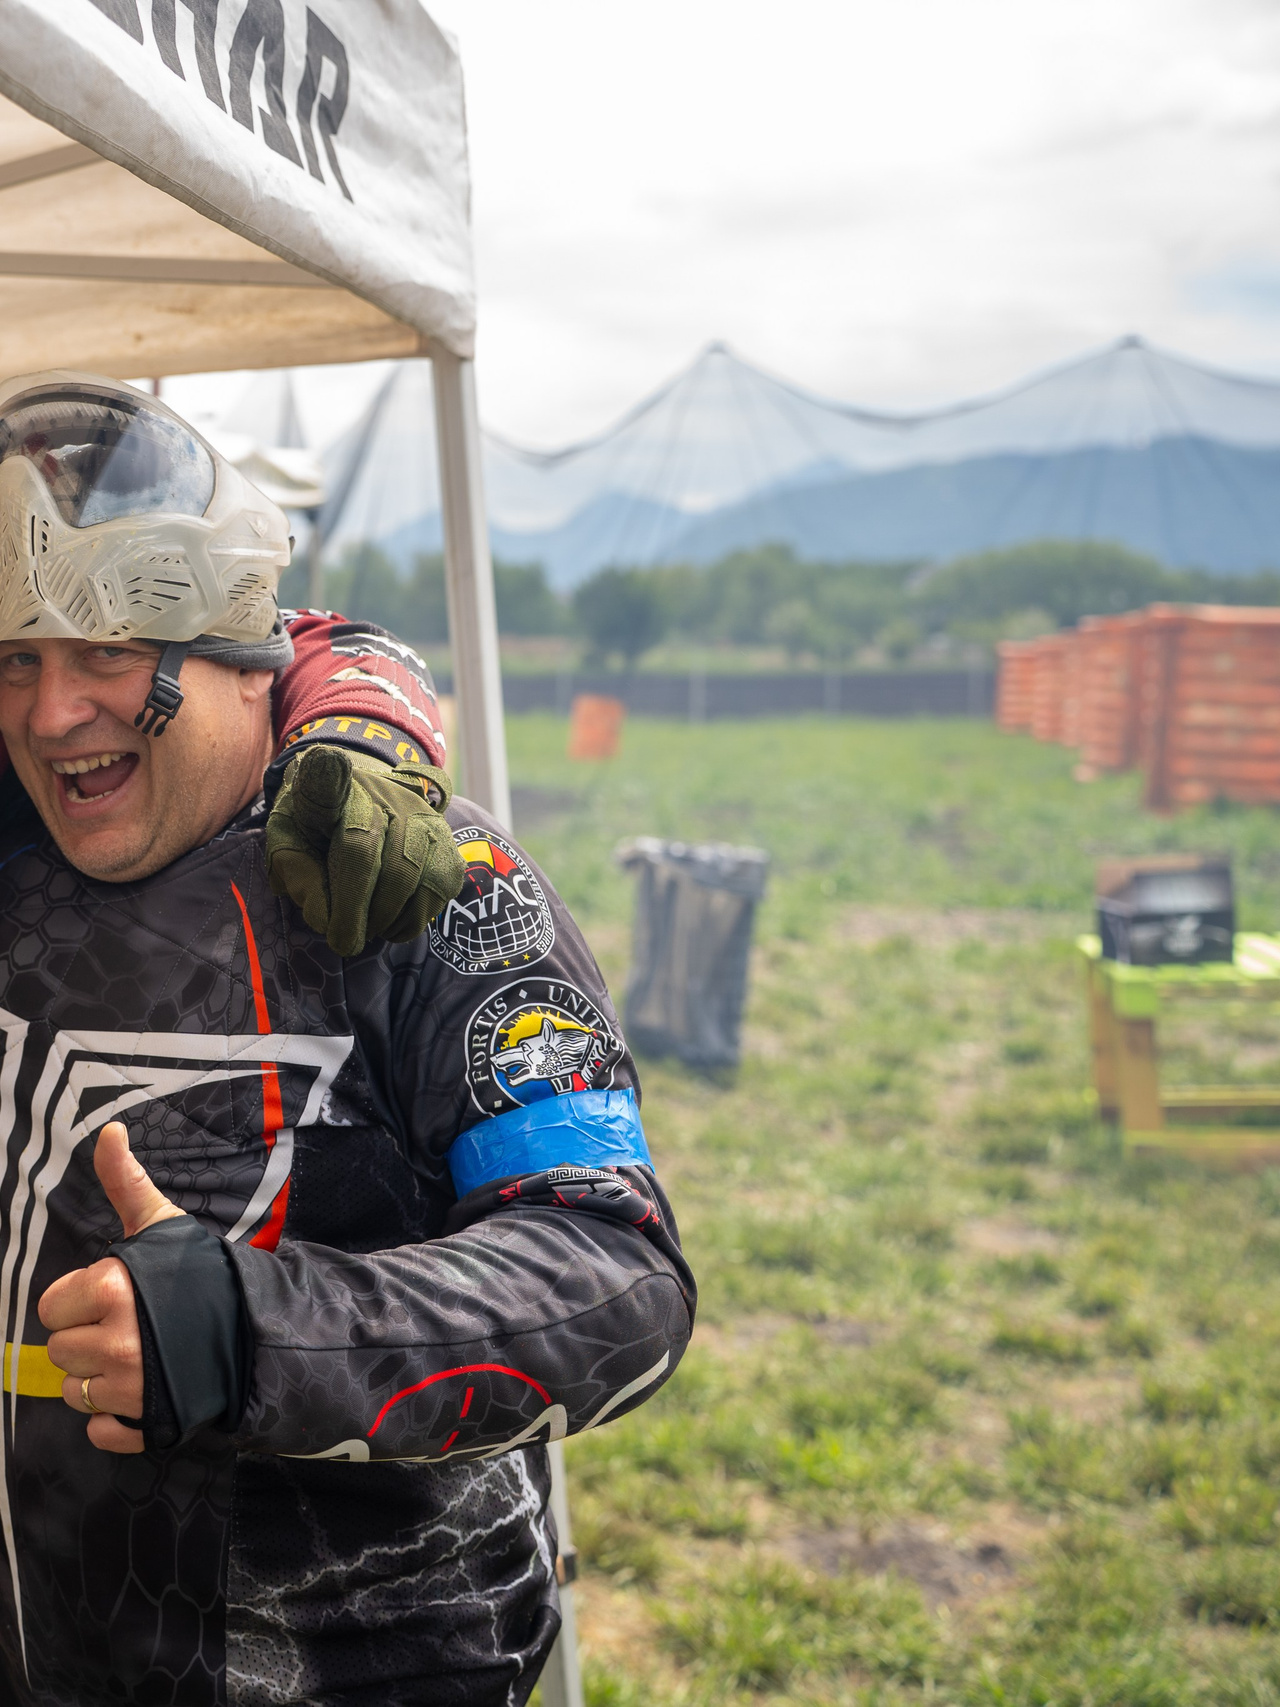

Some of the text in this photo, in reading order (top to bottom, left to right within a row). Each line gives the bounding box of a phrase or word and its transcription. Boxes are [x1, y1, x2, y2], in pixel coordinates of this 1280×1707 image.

[87, 0, 354, 204] HAR
[472, 984, 604, 1085] FORTIS UNIT
